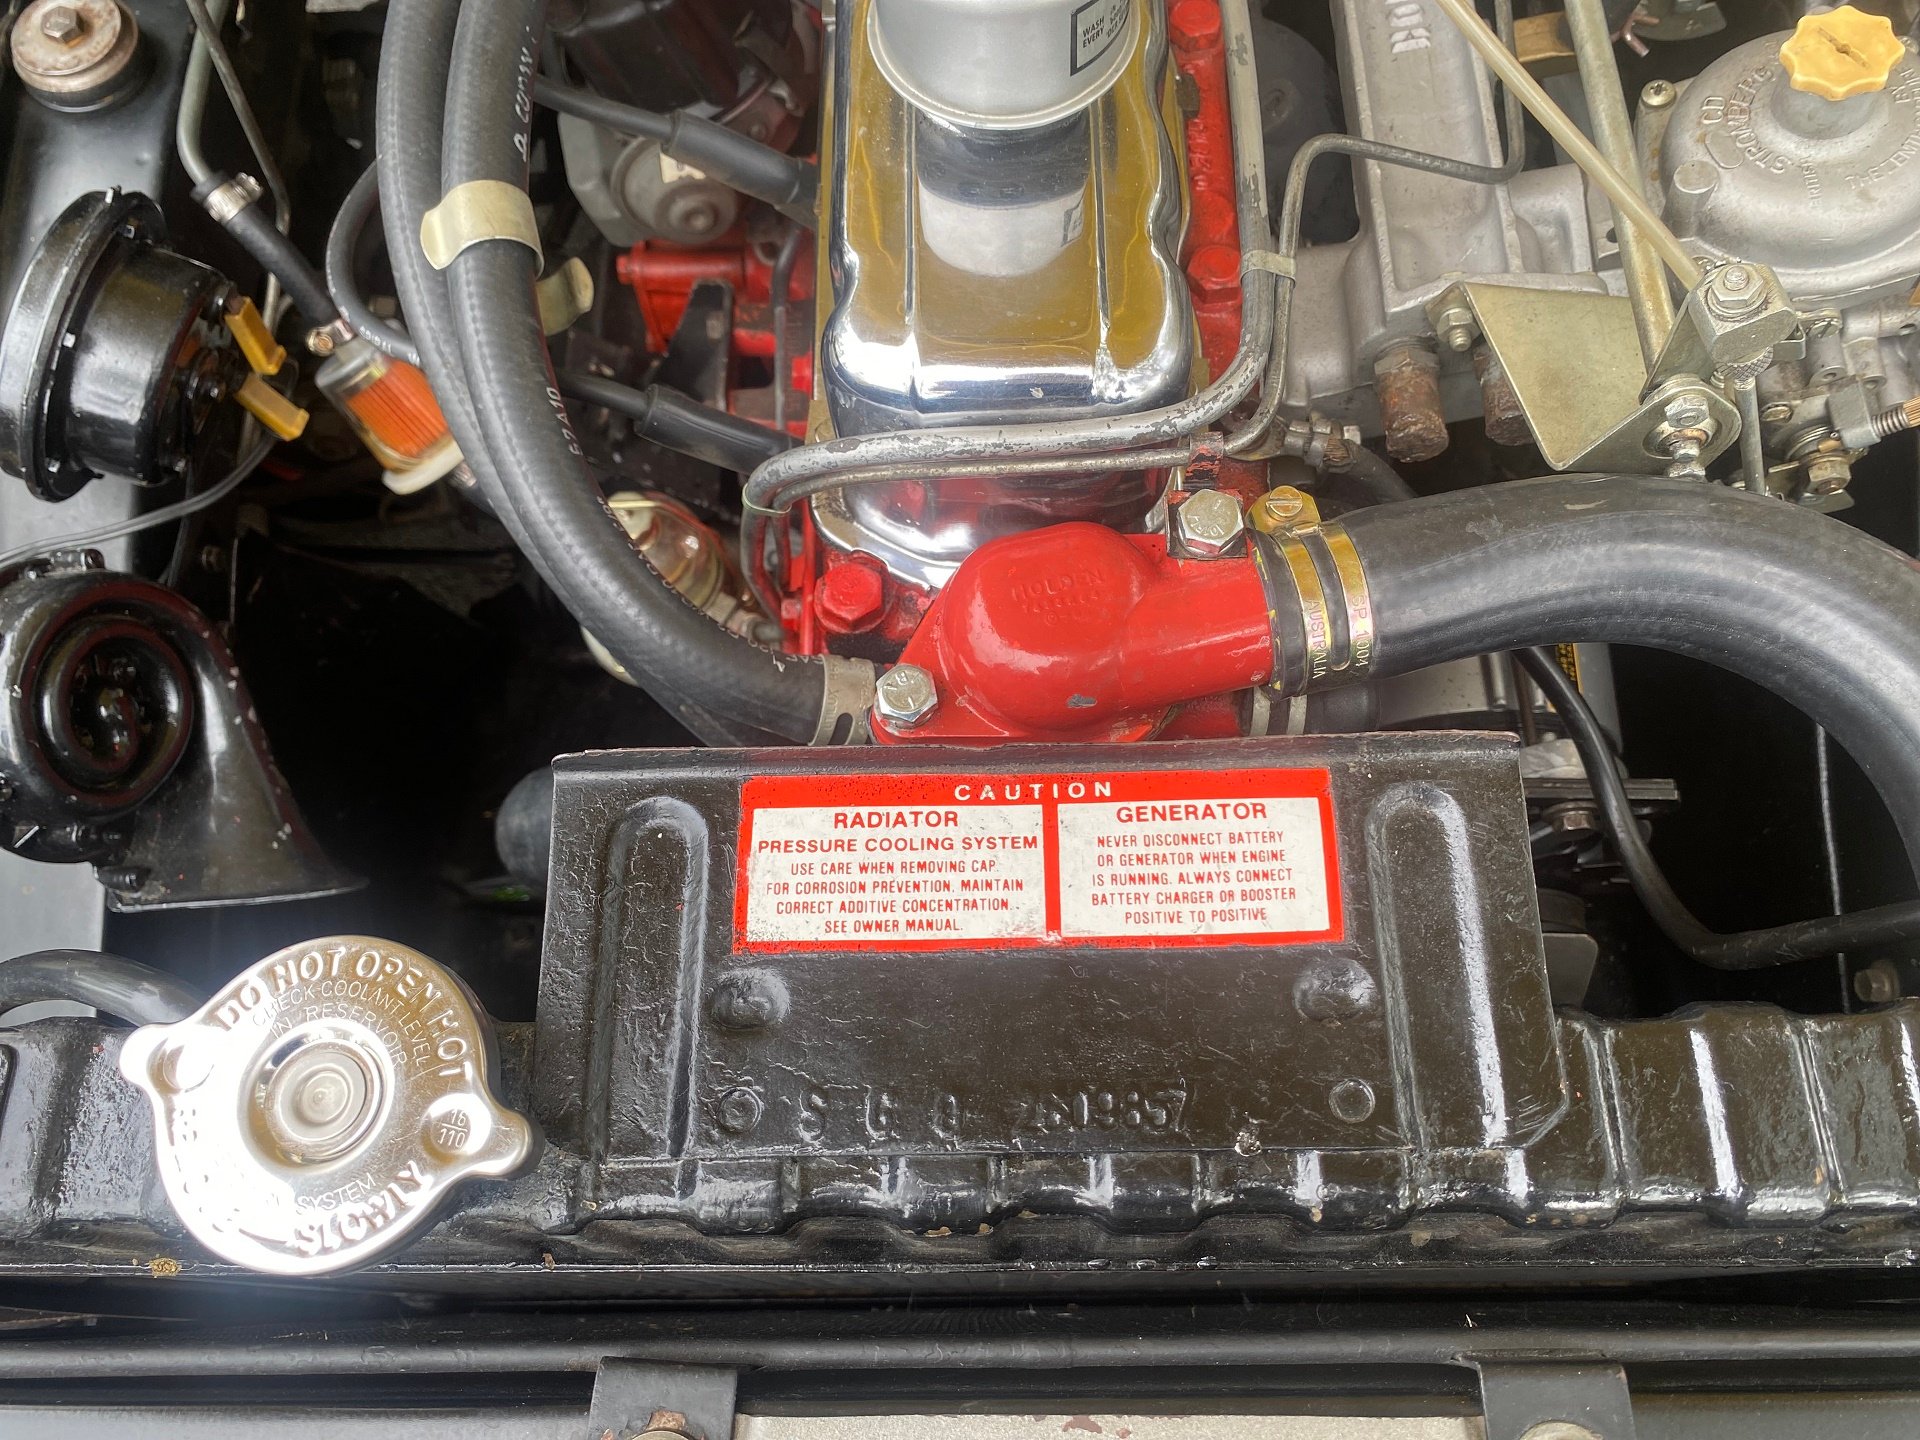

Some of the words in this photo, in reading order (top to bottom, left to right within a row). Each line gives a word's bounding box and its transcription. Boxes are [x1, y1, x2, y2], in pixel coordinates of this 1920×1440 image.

[1083, 16, 1104, 38] WASH
[1083, 25, 1105, 48] EVERY
[1702, 96, 1726, 125] CD
[1725, 64, 1793, 175] STROMBERG
[1306, 599, 1328, 679] AUSTRALIA
[954, 782, 1112, 801] CAUTION
[834, 810, 959, 829] RADIATOR
[1116, 802, 1267, 823] GENERATOR
[759, 839, 857, 853] PRESSURE
[865, 838, 954, 852] COOLING
[962, 836, 1038, 850] SYSTEM
[1097, 835, 1137, 848] NEVER
[1143, 833, 1222, 847] DISCONNECT
[1229, 831, 1284, 844] BATTERY
[791, 862, 814, 875] USE
[821, 862, 852, 875] CARE
[859, 861, 894, 874] WHEN
[901, 860, 965, 873] REMOVING
[971, 859, 998, 872] CAP.
[1097, 854, 1113, 867] OR
[1120, 852, 1194, 866] GENERATOR
[1200, 851, 1236, 864] WHEN
[1242, 850, 1286, 863] ENGINE
[767, 882, 789, 895] FOR
[795, 881, 866, 894] CORROSION
[961, 878, 1023, 892] MAINTAIN
[1092, 874, 1104, 886] IS
[1111, 872, 1172, 886] RUNNING.
[1178, 870, 1231, 884] ALWAYS
[1236, 868, 1293, 883] CONNECT
[776, 901, 833, 915] CORRECT
[839, 900, 896, 914] ADDITIVE
[902, 898, 1011, 913] CONCENTRATION.
[1092, 892, 1150, 906] BATTERY
[1156, 890, 1214, 904] CHARGER
[1220, 890, 1235, 902] OR
[1241, 888, 1296, 901] BOOSTER
[825, 920, 847, 933] SEE
[854, 919, 899, 933] OWNER
[905, 918, 963, 932] MANUAL.
[1125, 911, 1184, 924] POSITIVE
[1190, 910, 1205, 923] TO
[1211, 908, 1267, 923] POSITIVE
[207, 979, 262, 1031] DO
[271, 946, 346, 994] NOT
[355, 950, 441, 1013] OPEN
[427, 1008, 474, 1081] HOT
[253, 983, 315, 1026] CHECK
[321, 980, 405, 1014] COOLANT
[398, 1011, 432, 1067] LEVEL
[270, 1016, 292, 1039] IN
[304, 1002, 408, 1068] RESERVOIR
[451, 1109, 467, 1127] 16
[437, 1128, 466, 1149] 110
[296, 1171, 376, 1214] SYSTEM
[295, 1159, 434, 1257] SLOWLY
